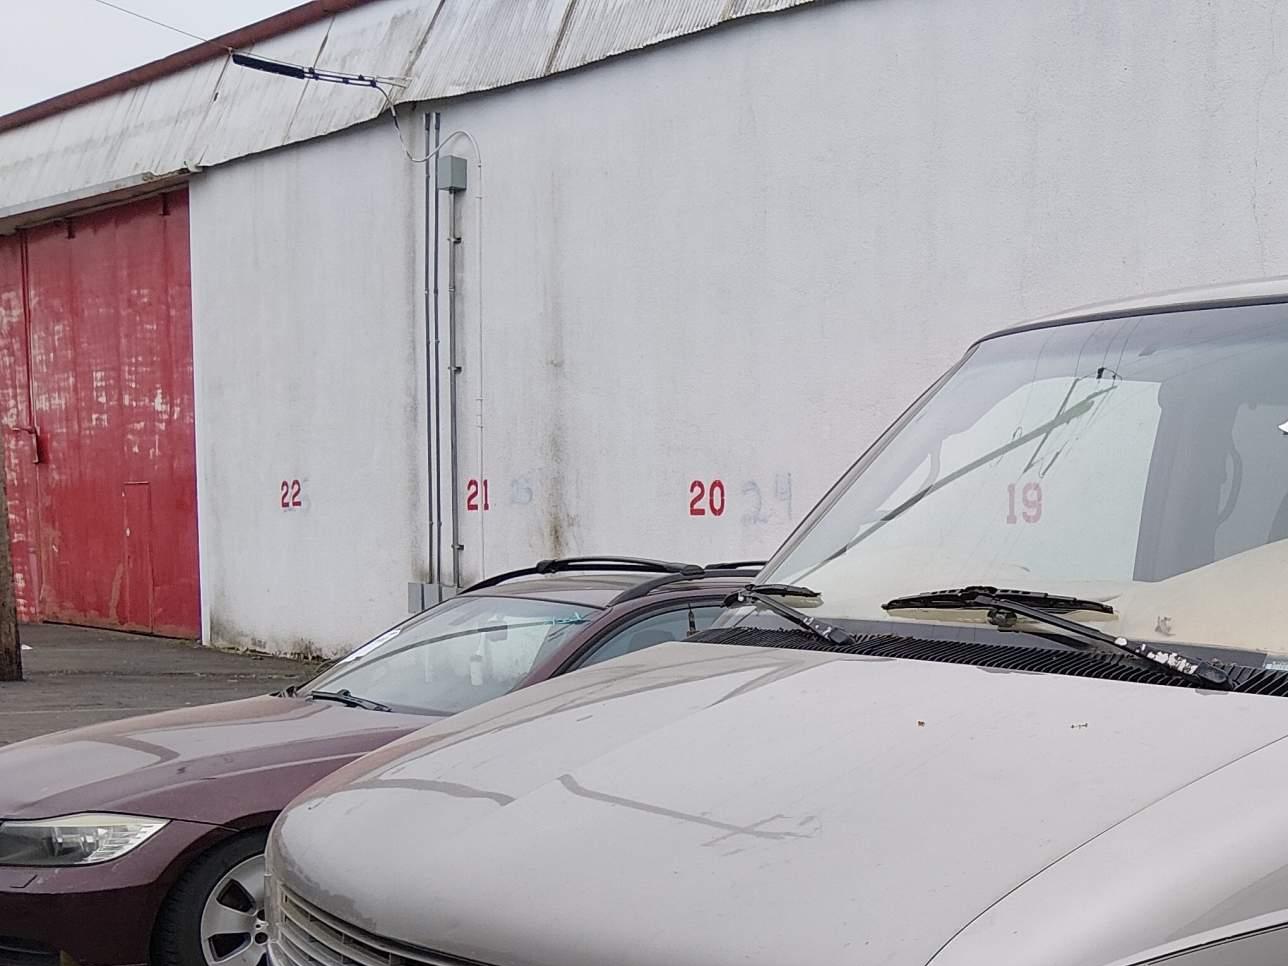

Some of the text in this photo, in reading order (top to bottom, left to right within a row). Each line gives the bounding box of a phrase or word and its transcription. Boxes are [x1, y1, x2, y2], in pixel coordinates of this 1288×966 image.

[280, 479, 302, 508] 22
[466, 479, 490, 511] 21
[689, 479, 726, 517] 20
[1005, 481, 1043, 525] 19
